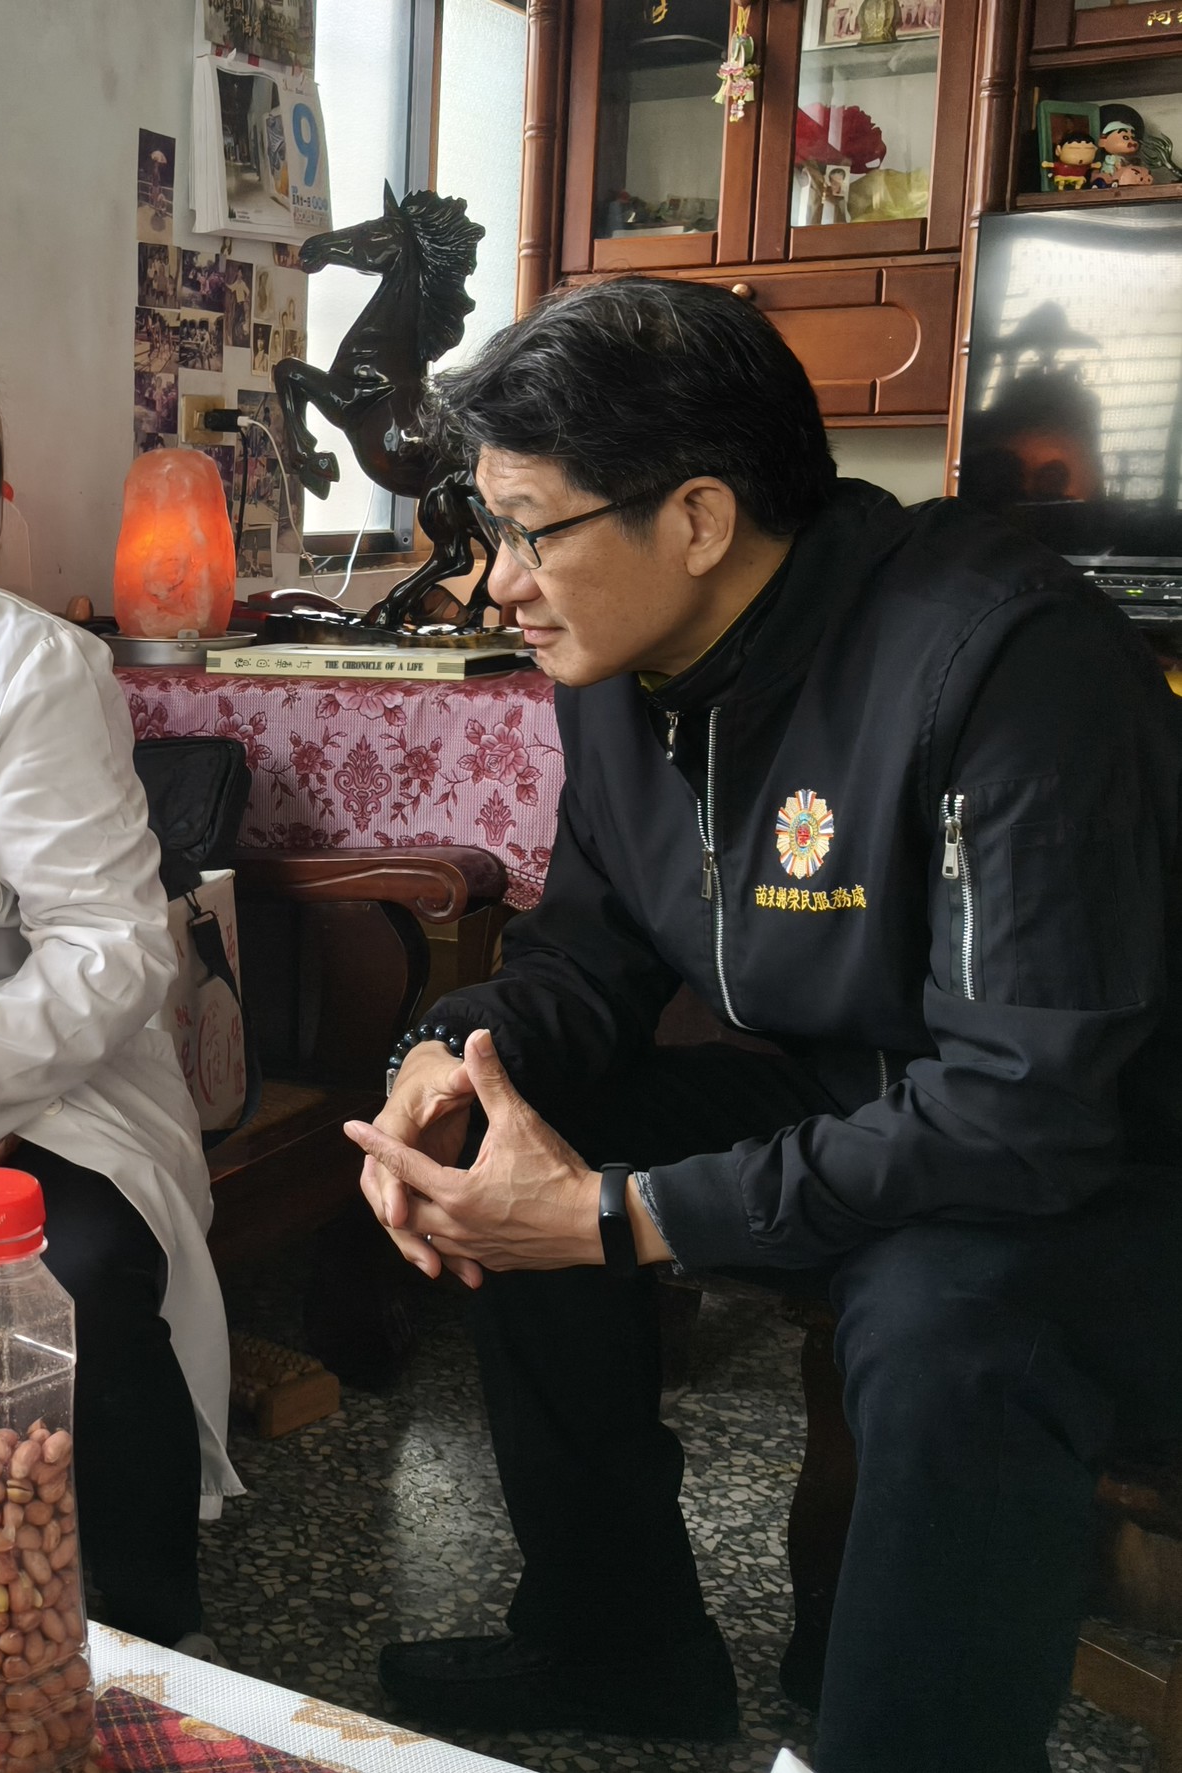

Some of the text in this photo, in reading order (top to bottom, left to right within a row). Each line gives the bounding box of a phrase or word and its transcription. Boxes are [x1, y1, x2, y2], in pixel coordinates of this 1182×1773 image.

[292, 102, 321, 188] 9
[324, 659, 339, 670] THE
[341, 660, 382, 671] CHRONICLE
[385, 661, 396, 671] OF
[398, 661, 404, 671] A
[406, 661, 424, 672] LIFE
[754, 883, 867, 912] 苗栗縣榮民服務處
